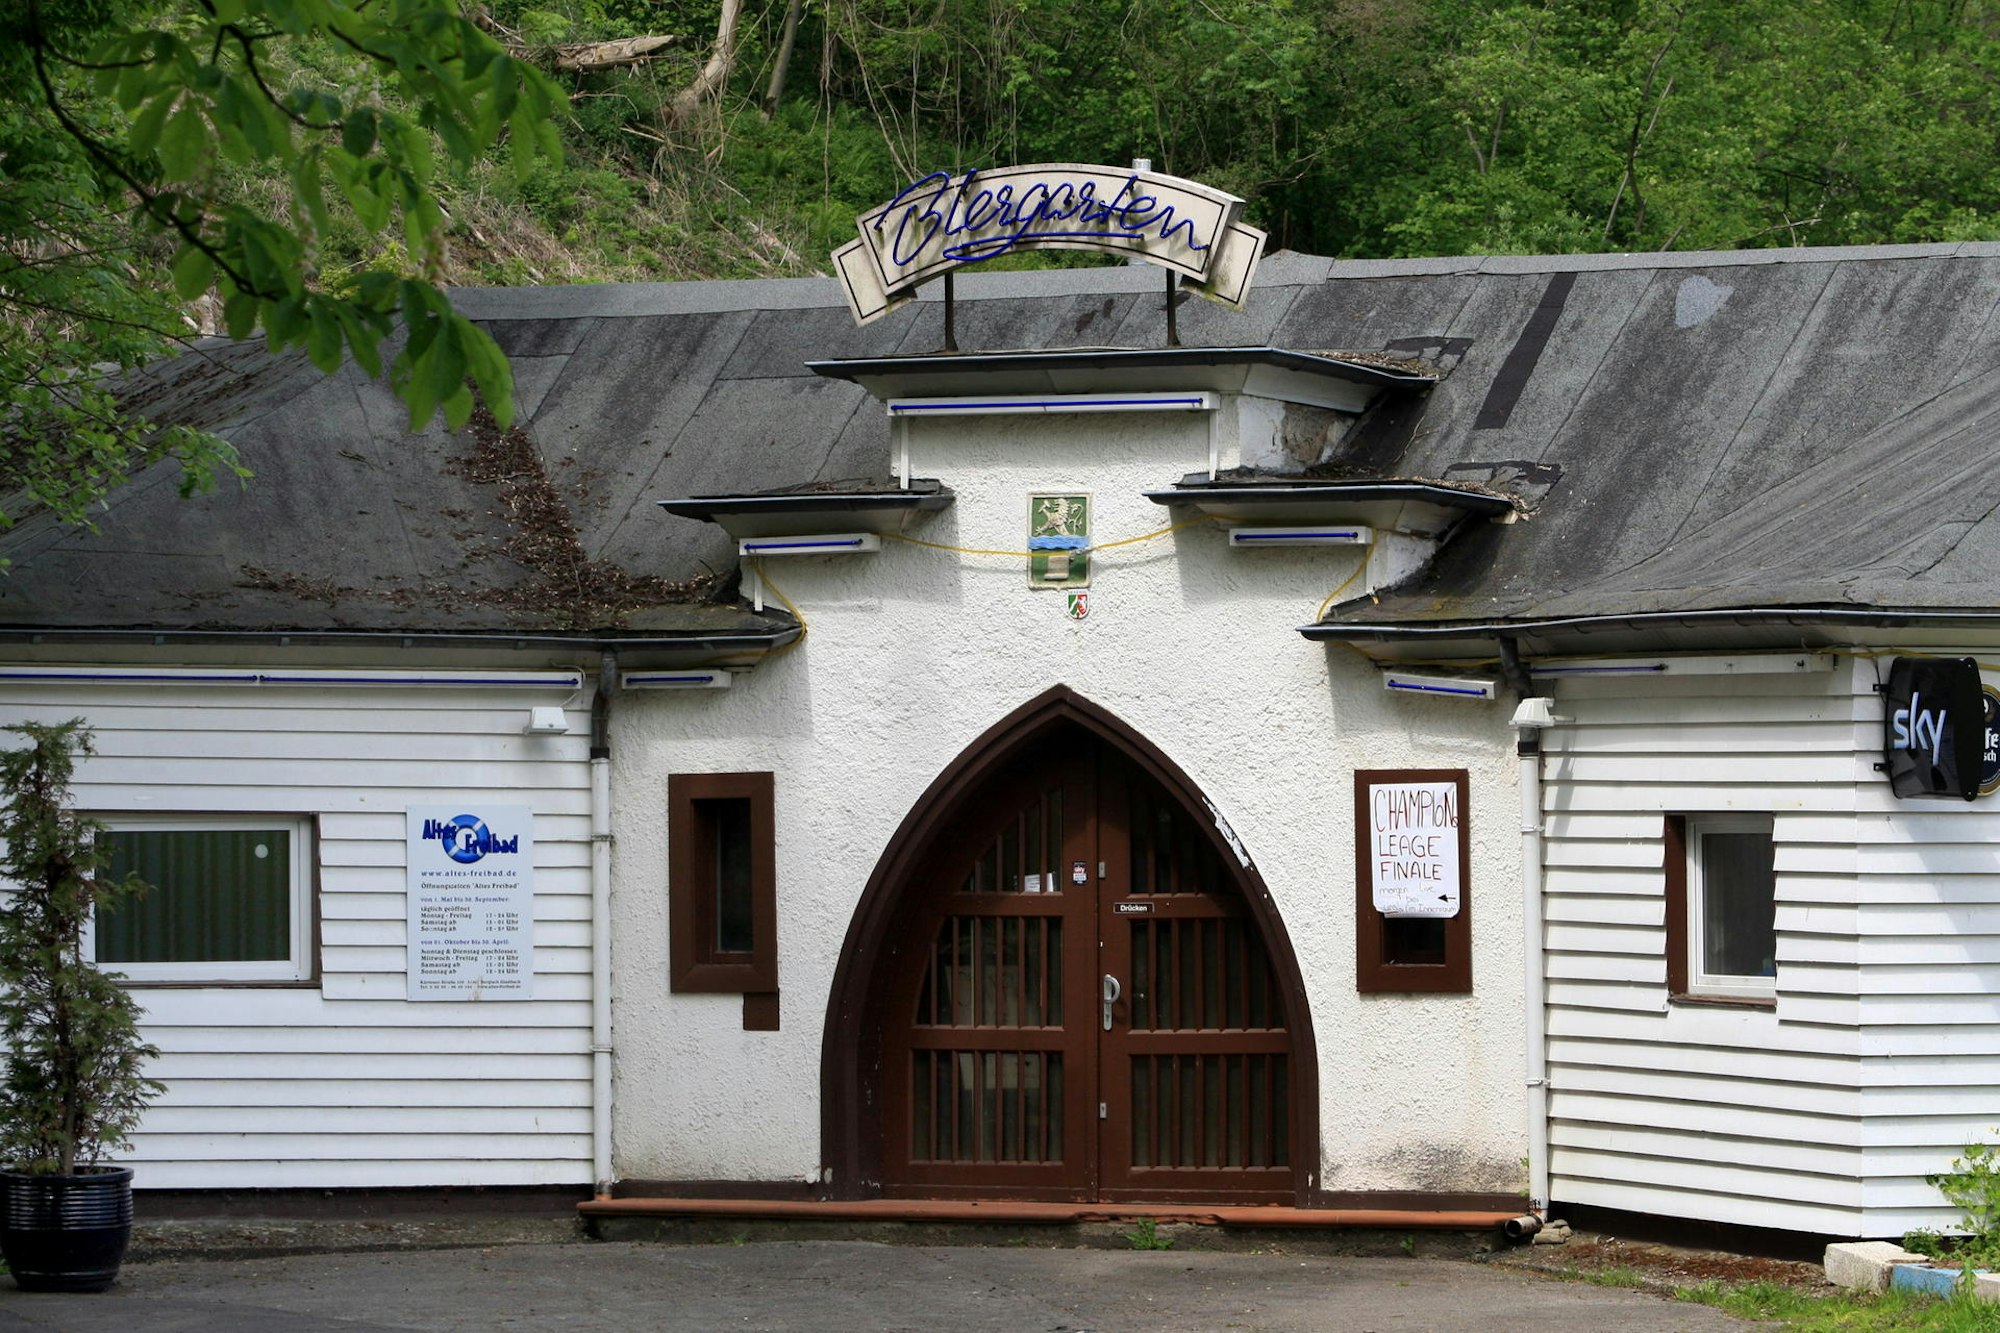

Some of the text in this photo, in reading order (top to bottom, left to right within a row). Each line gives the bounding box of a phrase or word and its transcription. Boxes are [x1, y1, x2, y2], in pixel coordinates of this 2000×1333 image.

[873, 167, 1210, 267] Biergarten
[1893, 691, 1947, 766] sky
[422, 819, 457, 840] Altes
[465, 833, 519, 854] Freibad
[1379, 835, 1443, 858] LEAGE
[1380, 861, 1444, 881] FINALE
[421, 882, 471, 890] Öffnungszeiten
[1119, 903, 1148, 912] Drücken
